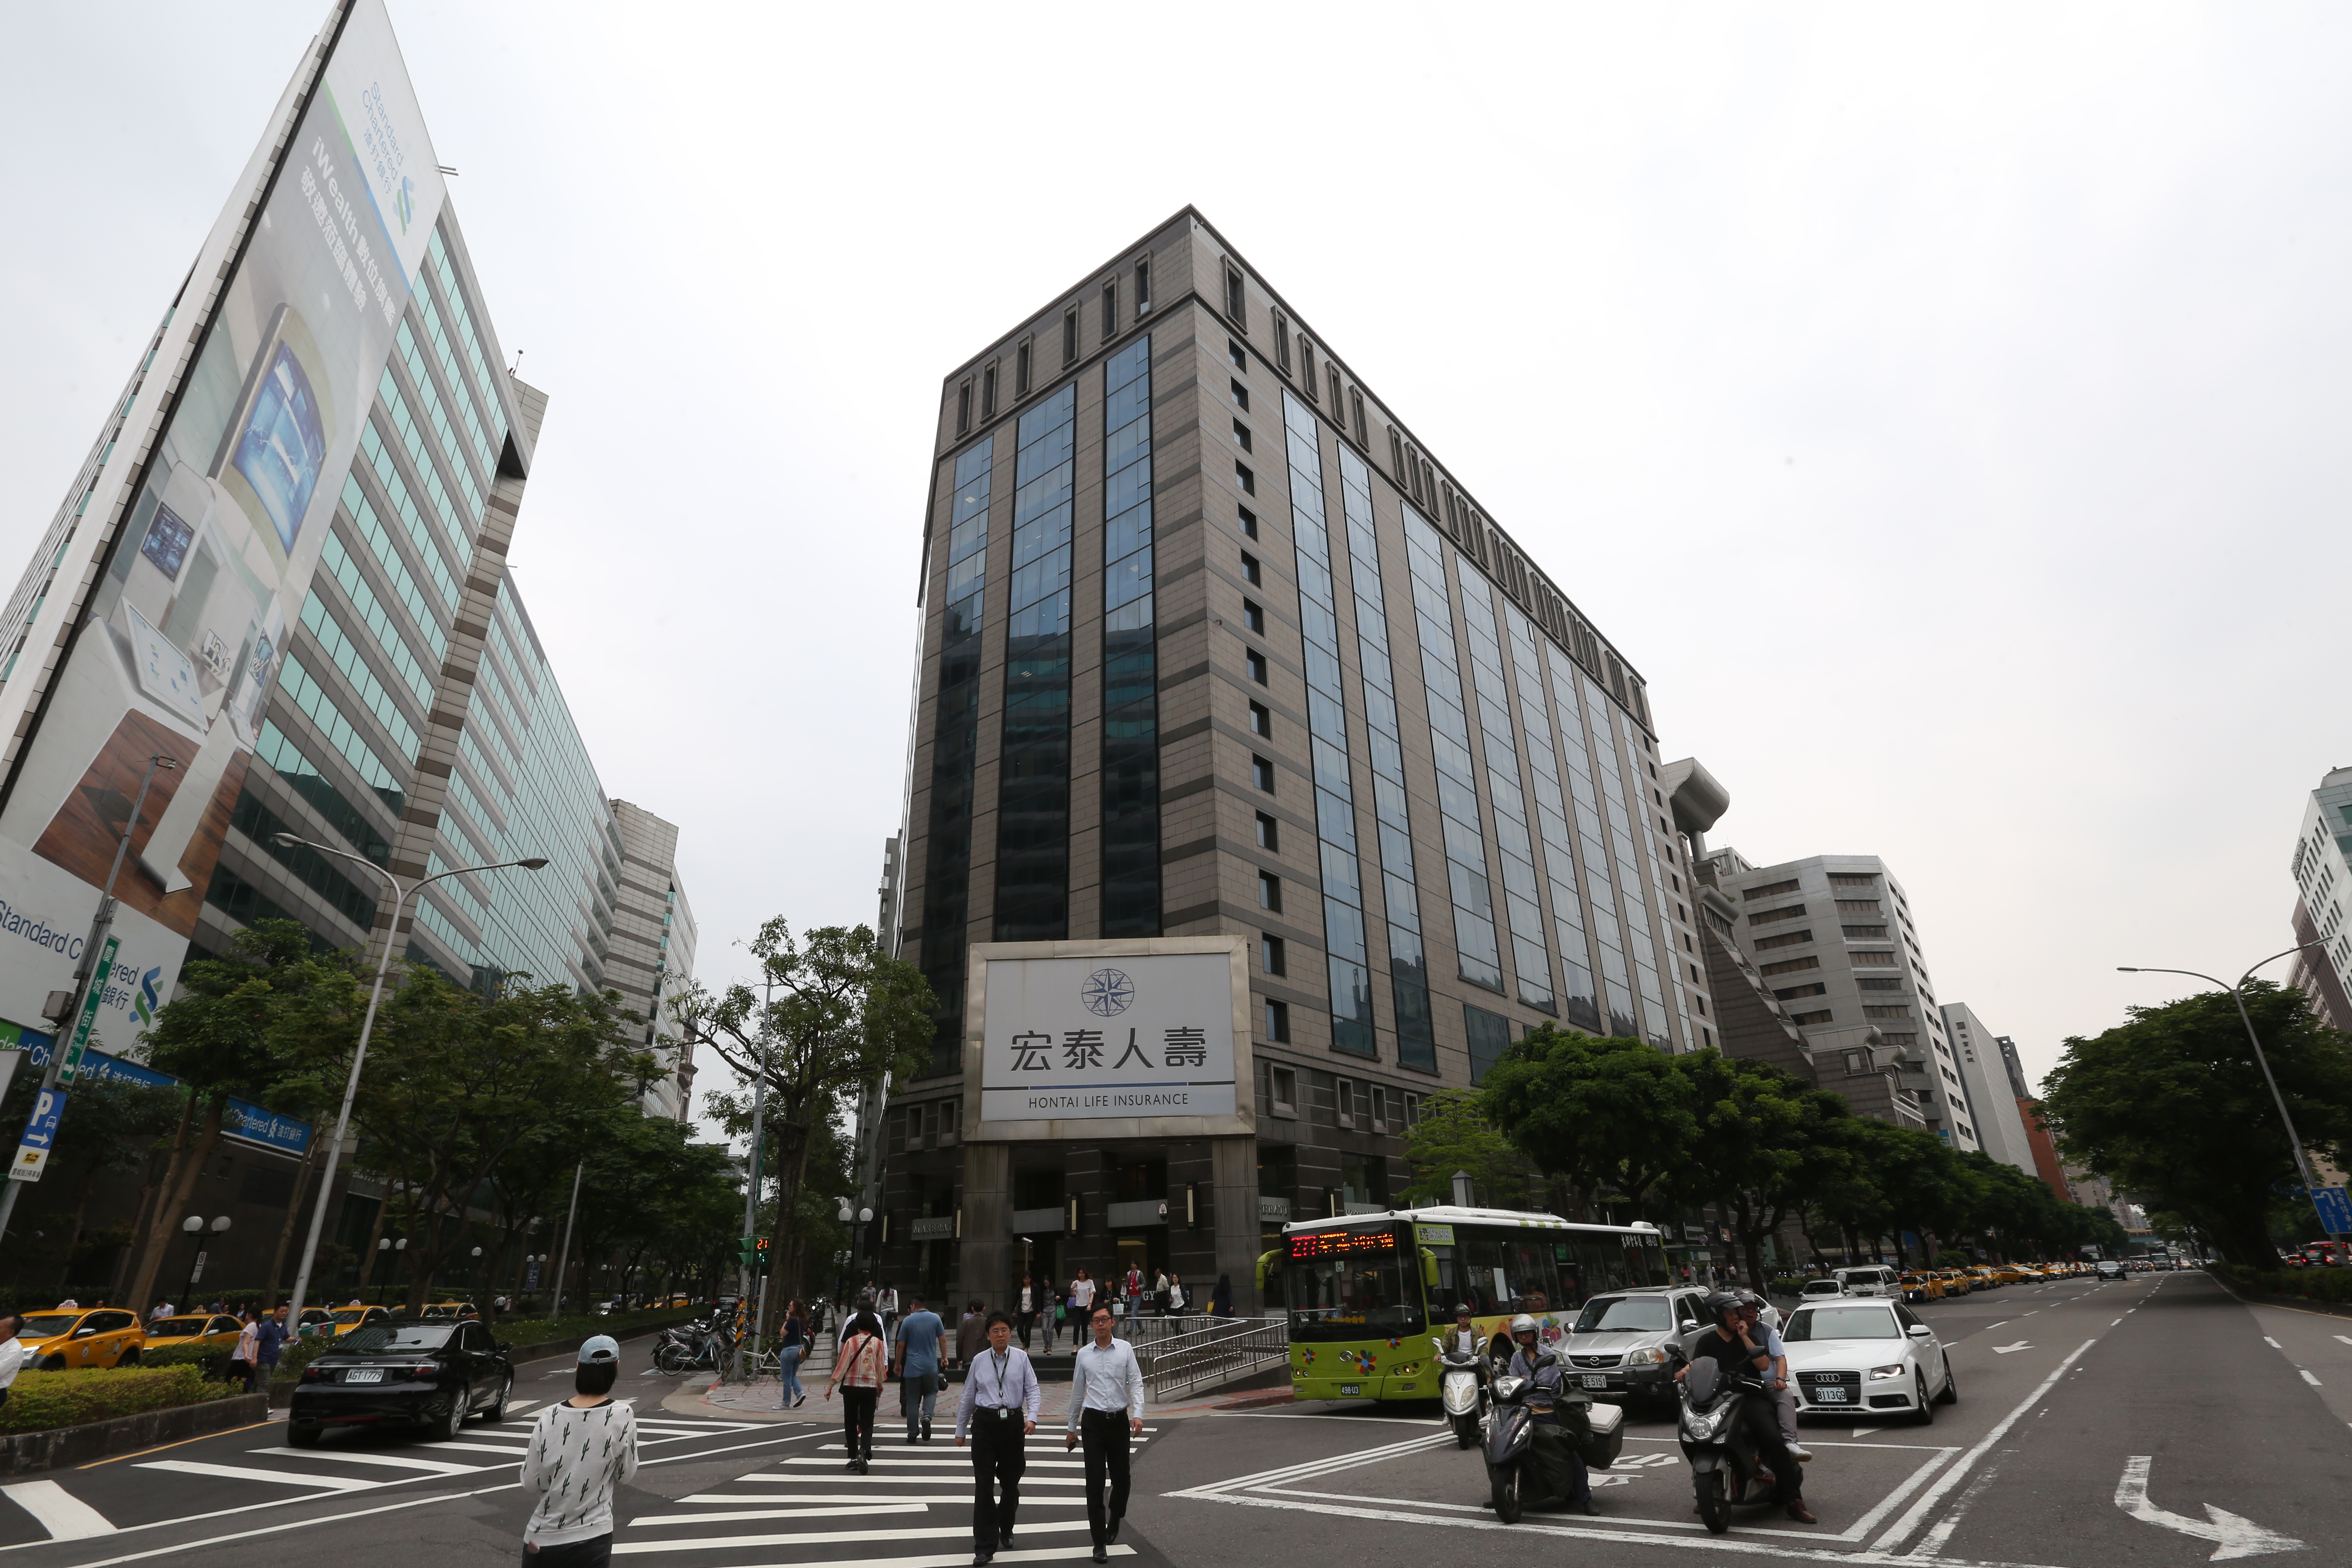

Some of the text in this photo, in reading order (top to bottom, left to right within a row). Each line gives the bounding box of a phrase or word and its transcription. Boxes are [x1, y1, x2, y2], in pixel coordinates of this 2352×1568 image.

[363, 90, 398, 181] Chartered
[372, 82, 404, 166] Standard
[364, 127, 391, 194] 渣打銀行
[1010, 1026, 1207, 1071] 宏泰人壽
[30, 1091, 53, 1126] P
[1029, 1094, 1188, 1108] HONTAI LIFE INSURANCE
[277, 1125, 302, 1142] 渣打銀行
[757, 1238, 768, 1250] 21
